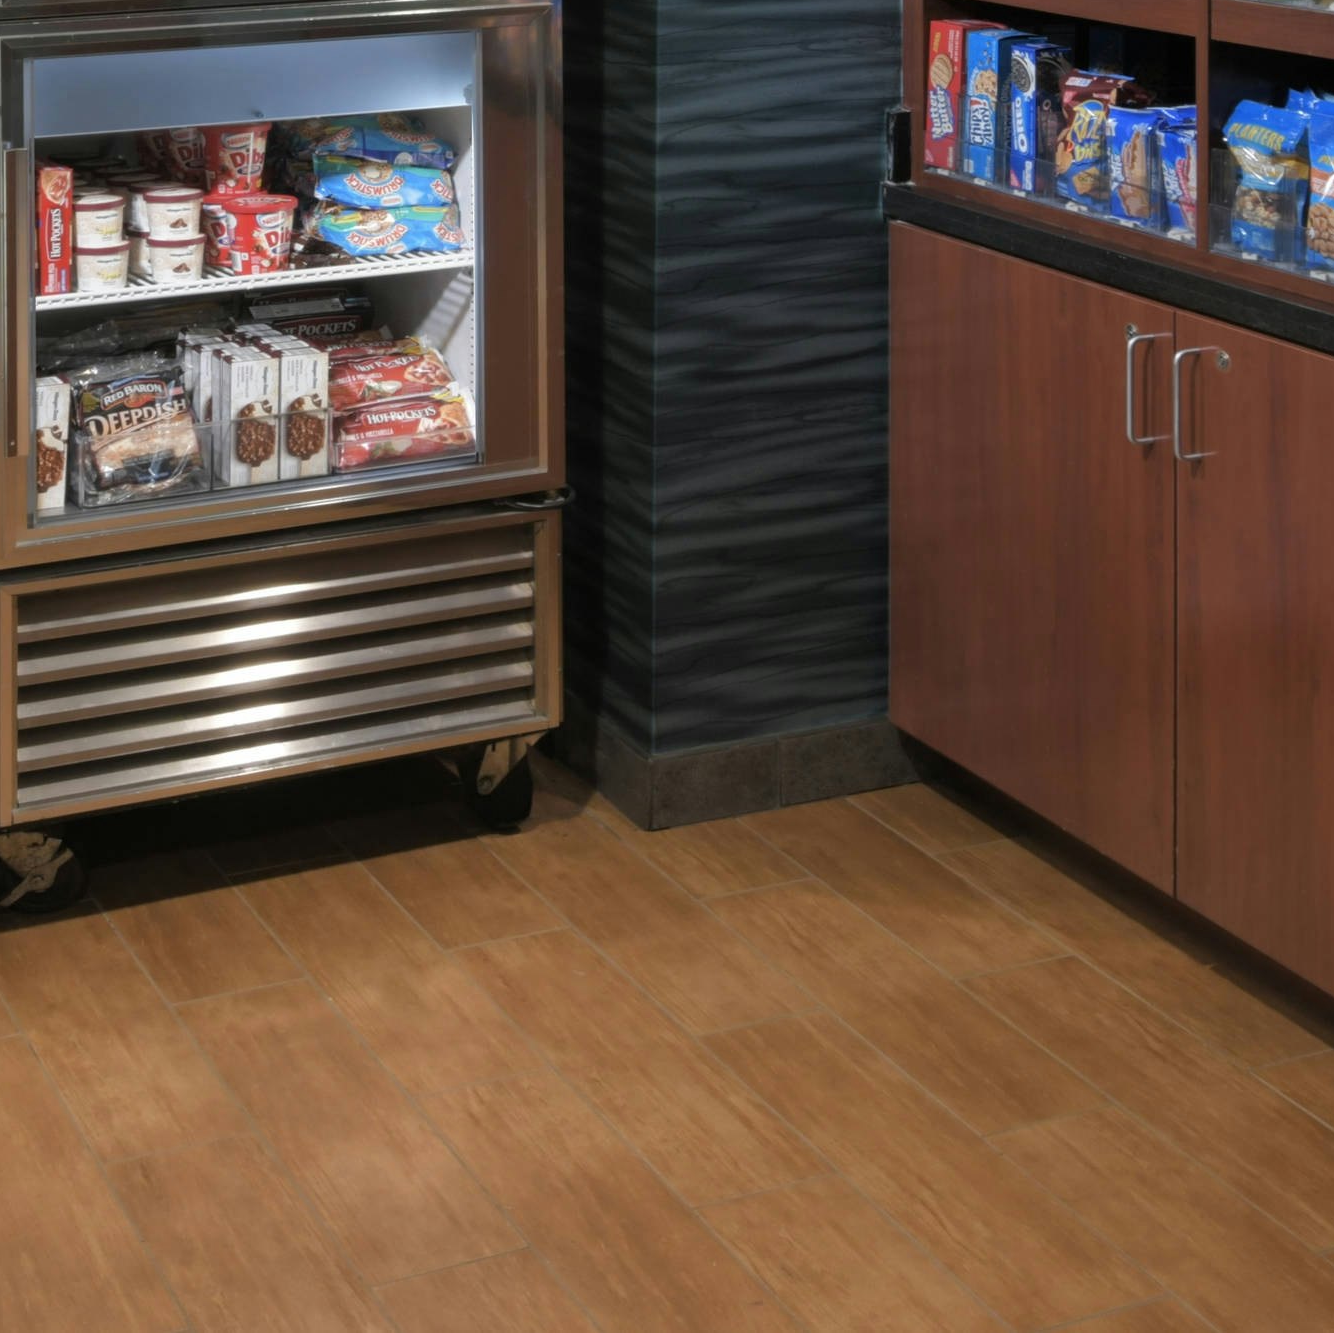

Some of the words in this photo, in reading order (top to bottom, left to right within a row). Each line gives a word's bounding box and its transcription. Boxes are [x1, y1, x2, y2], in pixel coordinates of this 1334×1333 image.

[930, 90, 942, 139] Nutter
[937, 87, 953, 134] Butter
[971, 107, 984, 146] Chips
[1014, 97, 1028, 154] OREO
[1227, 122, 1286, 152] PLANTERS
[49, 241, 61, 259] HOT
[299, 319, 356, 336] POCKETS
[103, 390, 125, 407] RED
[124, 382, 163, 396] BARON
